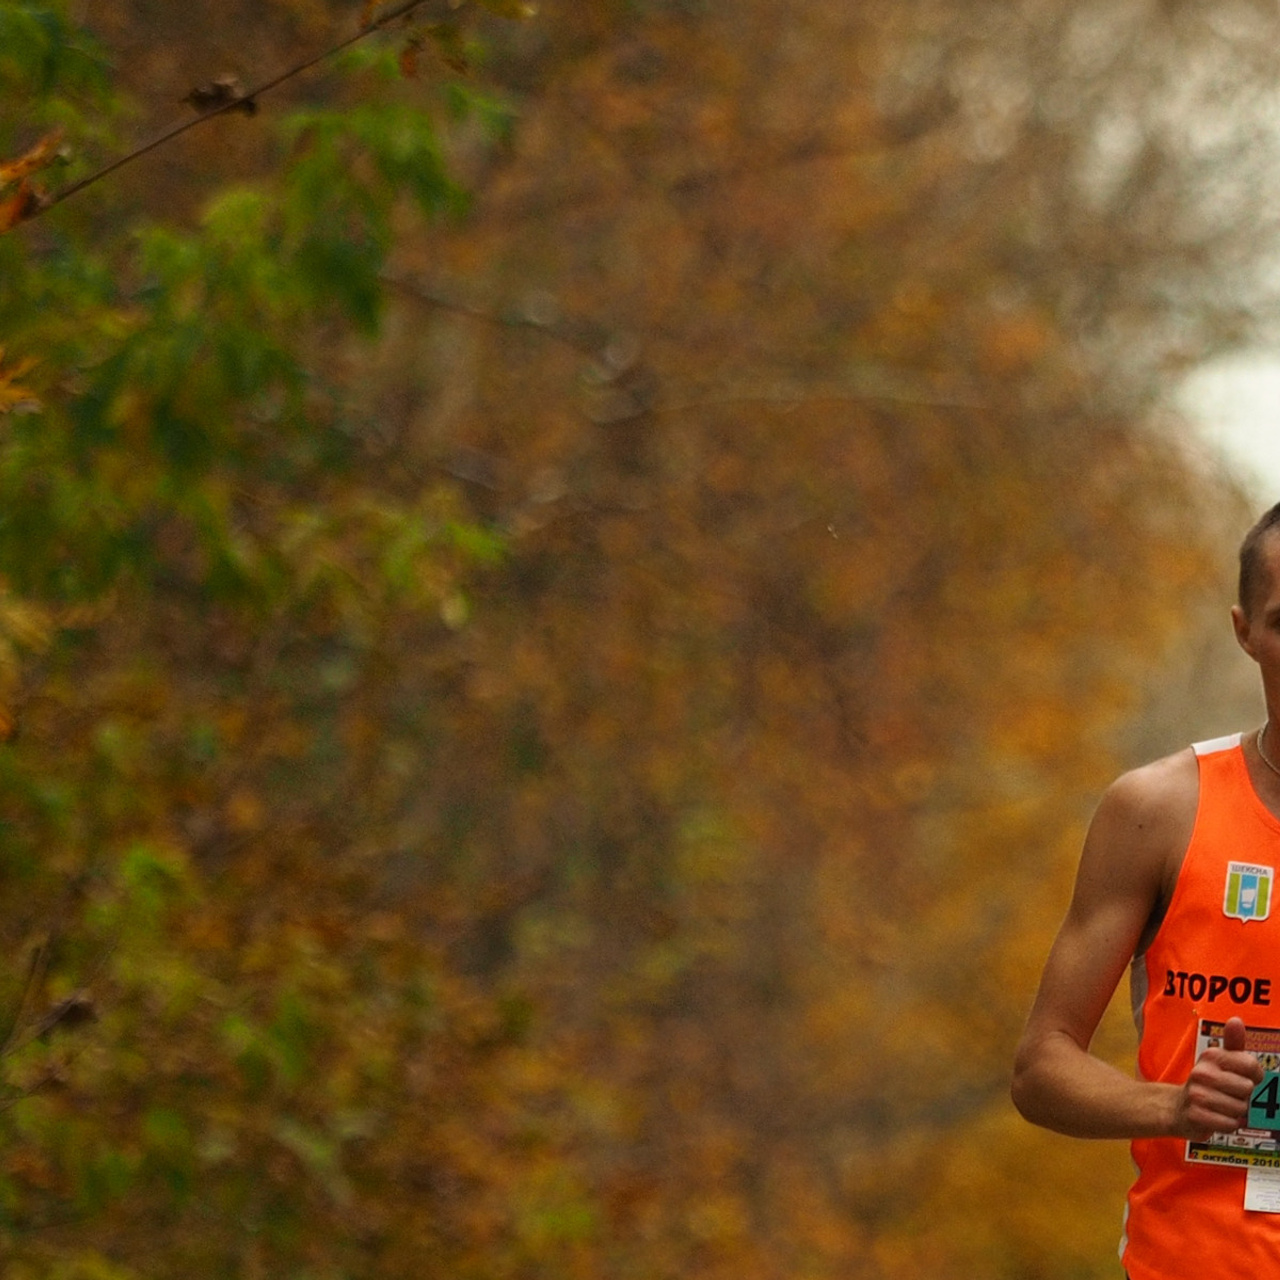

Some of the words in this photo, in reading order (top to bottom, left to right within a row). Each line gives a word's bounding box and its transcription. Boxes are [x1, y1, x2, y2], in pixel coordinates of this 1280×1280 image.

[1231, 863, 1268, 875] ШЕКСНА
[1163, 969, 1272, 1006] ВТОРОЕ
[1203, 1153, 1248, 1165] октября
[1252, 1157, 1280, 1167] 2016
